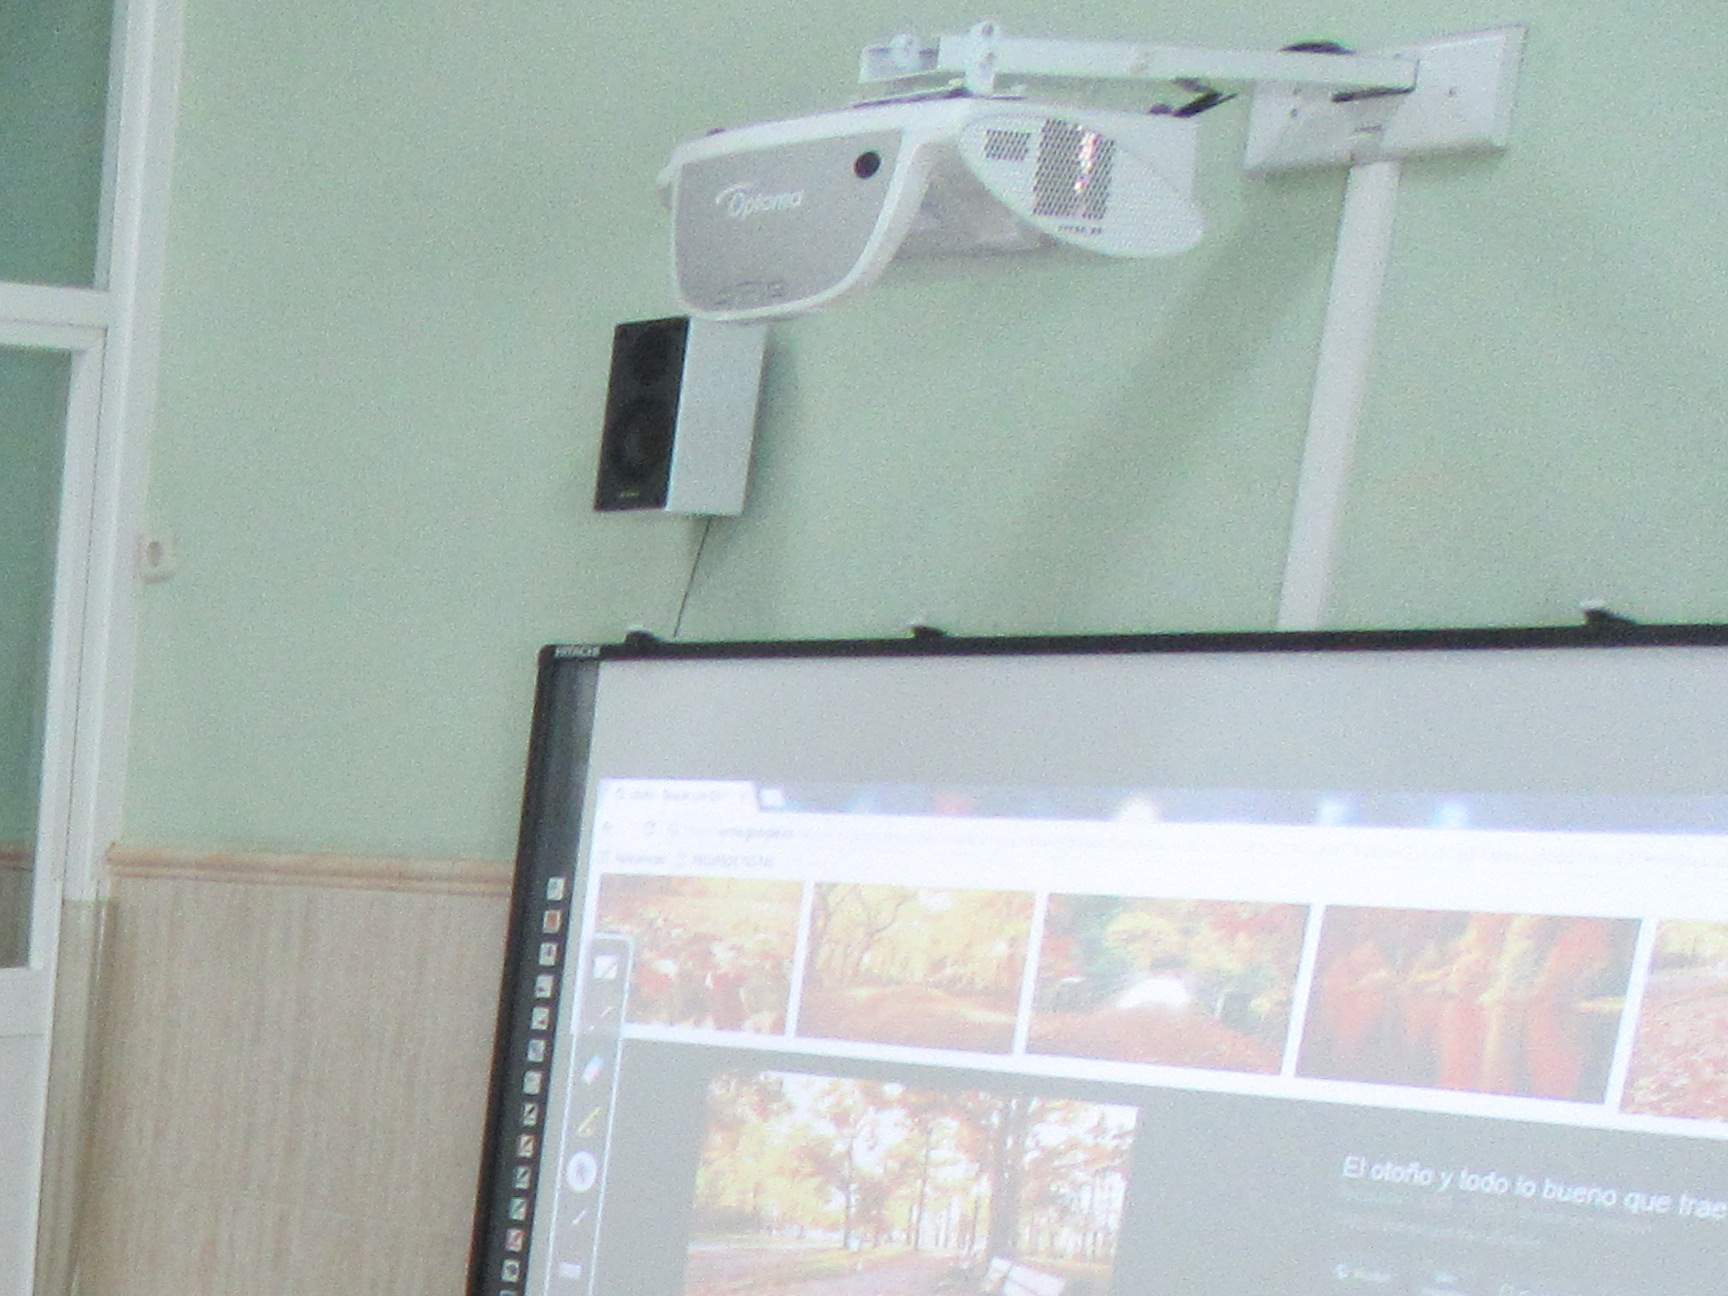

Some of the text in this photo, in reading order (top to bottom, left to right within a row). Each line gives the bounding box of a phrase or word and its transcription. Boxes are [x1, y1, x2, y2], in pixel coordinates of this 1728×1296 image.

[1343, 1155, 1365, 1178] El
[1370, 1160, 1433, 1186] otoño
[1437, 1170, 1454, 1193] y
[1459, 1168, 1508, 1193] todo
[1543, 1179, 1617, 1207] bueno
[1623, 1191, 1670, 1214] que
